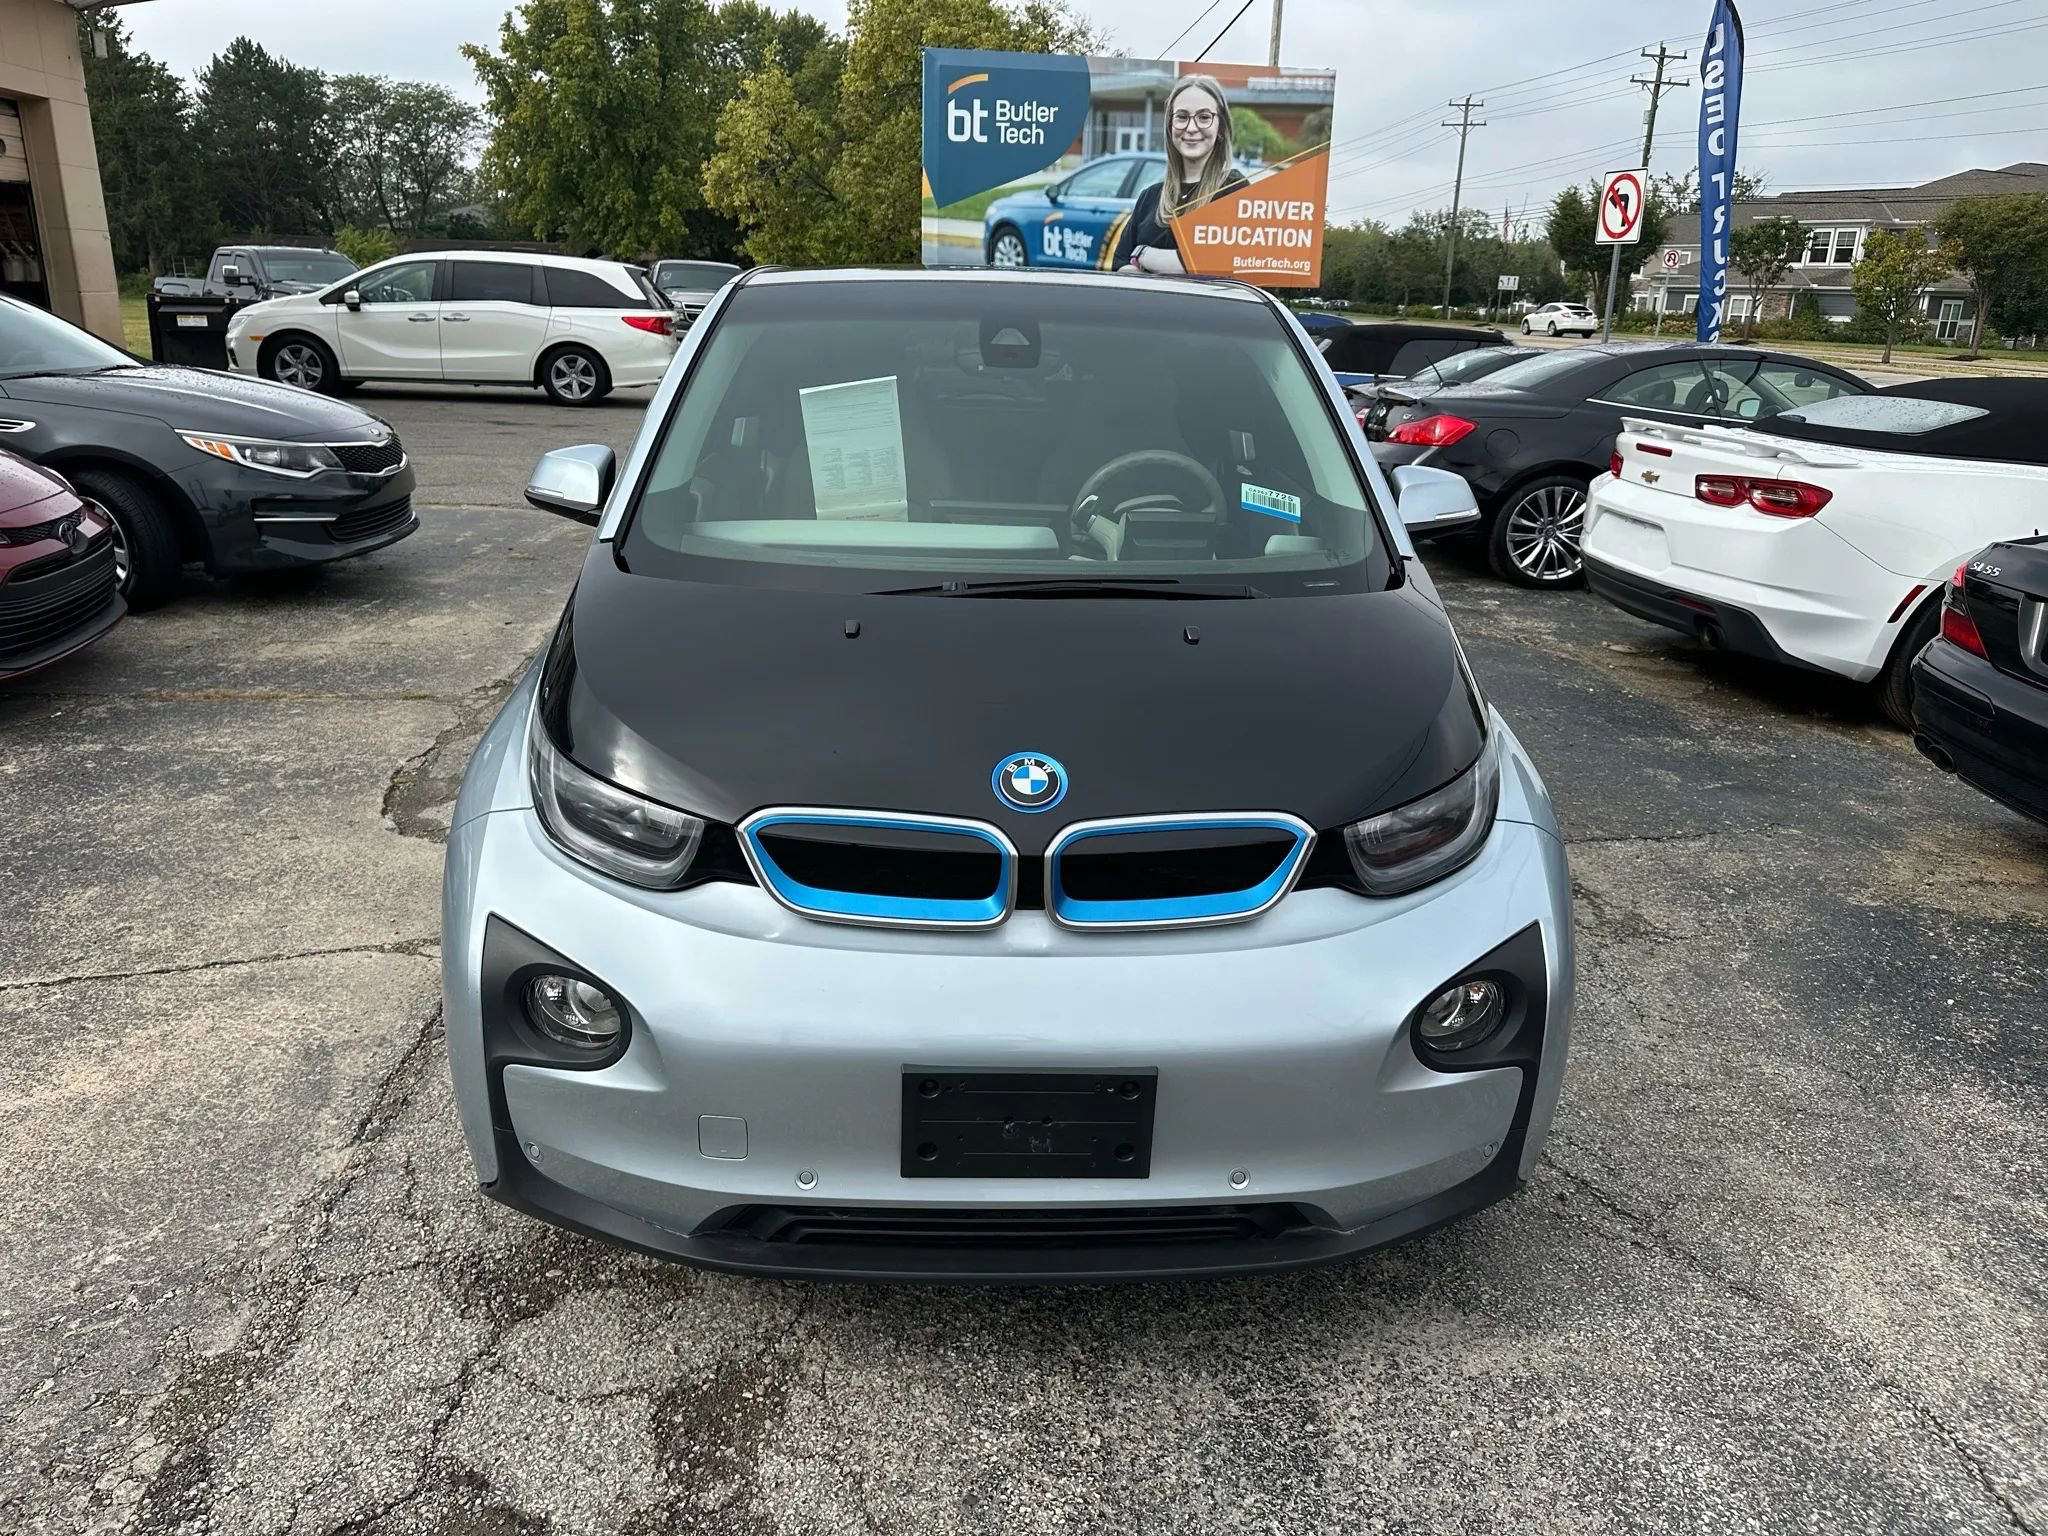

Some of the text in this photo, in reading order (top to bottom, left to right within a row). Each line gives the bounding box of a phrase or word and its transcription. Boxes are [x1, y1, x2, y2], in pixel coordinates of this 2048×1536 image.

[947, 98, 989, 143] bt
[996, 99, 1059, 123] Butler
[995, 122, 1045, 145] Tech
[1237, 199, 1315, 221] DRIVER
[1043, 225, 1063, 257] bt
[1193, 225, 1313, 248] EDUCATION
[1233, 256, 1311, 271] ButlerTech.org
[1006, 758, 1055, 773] BMW
